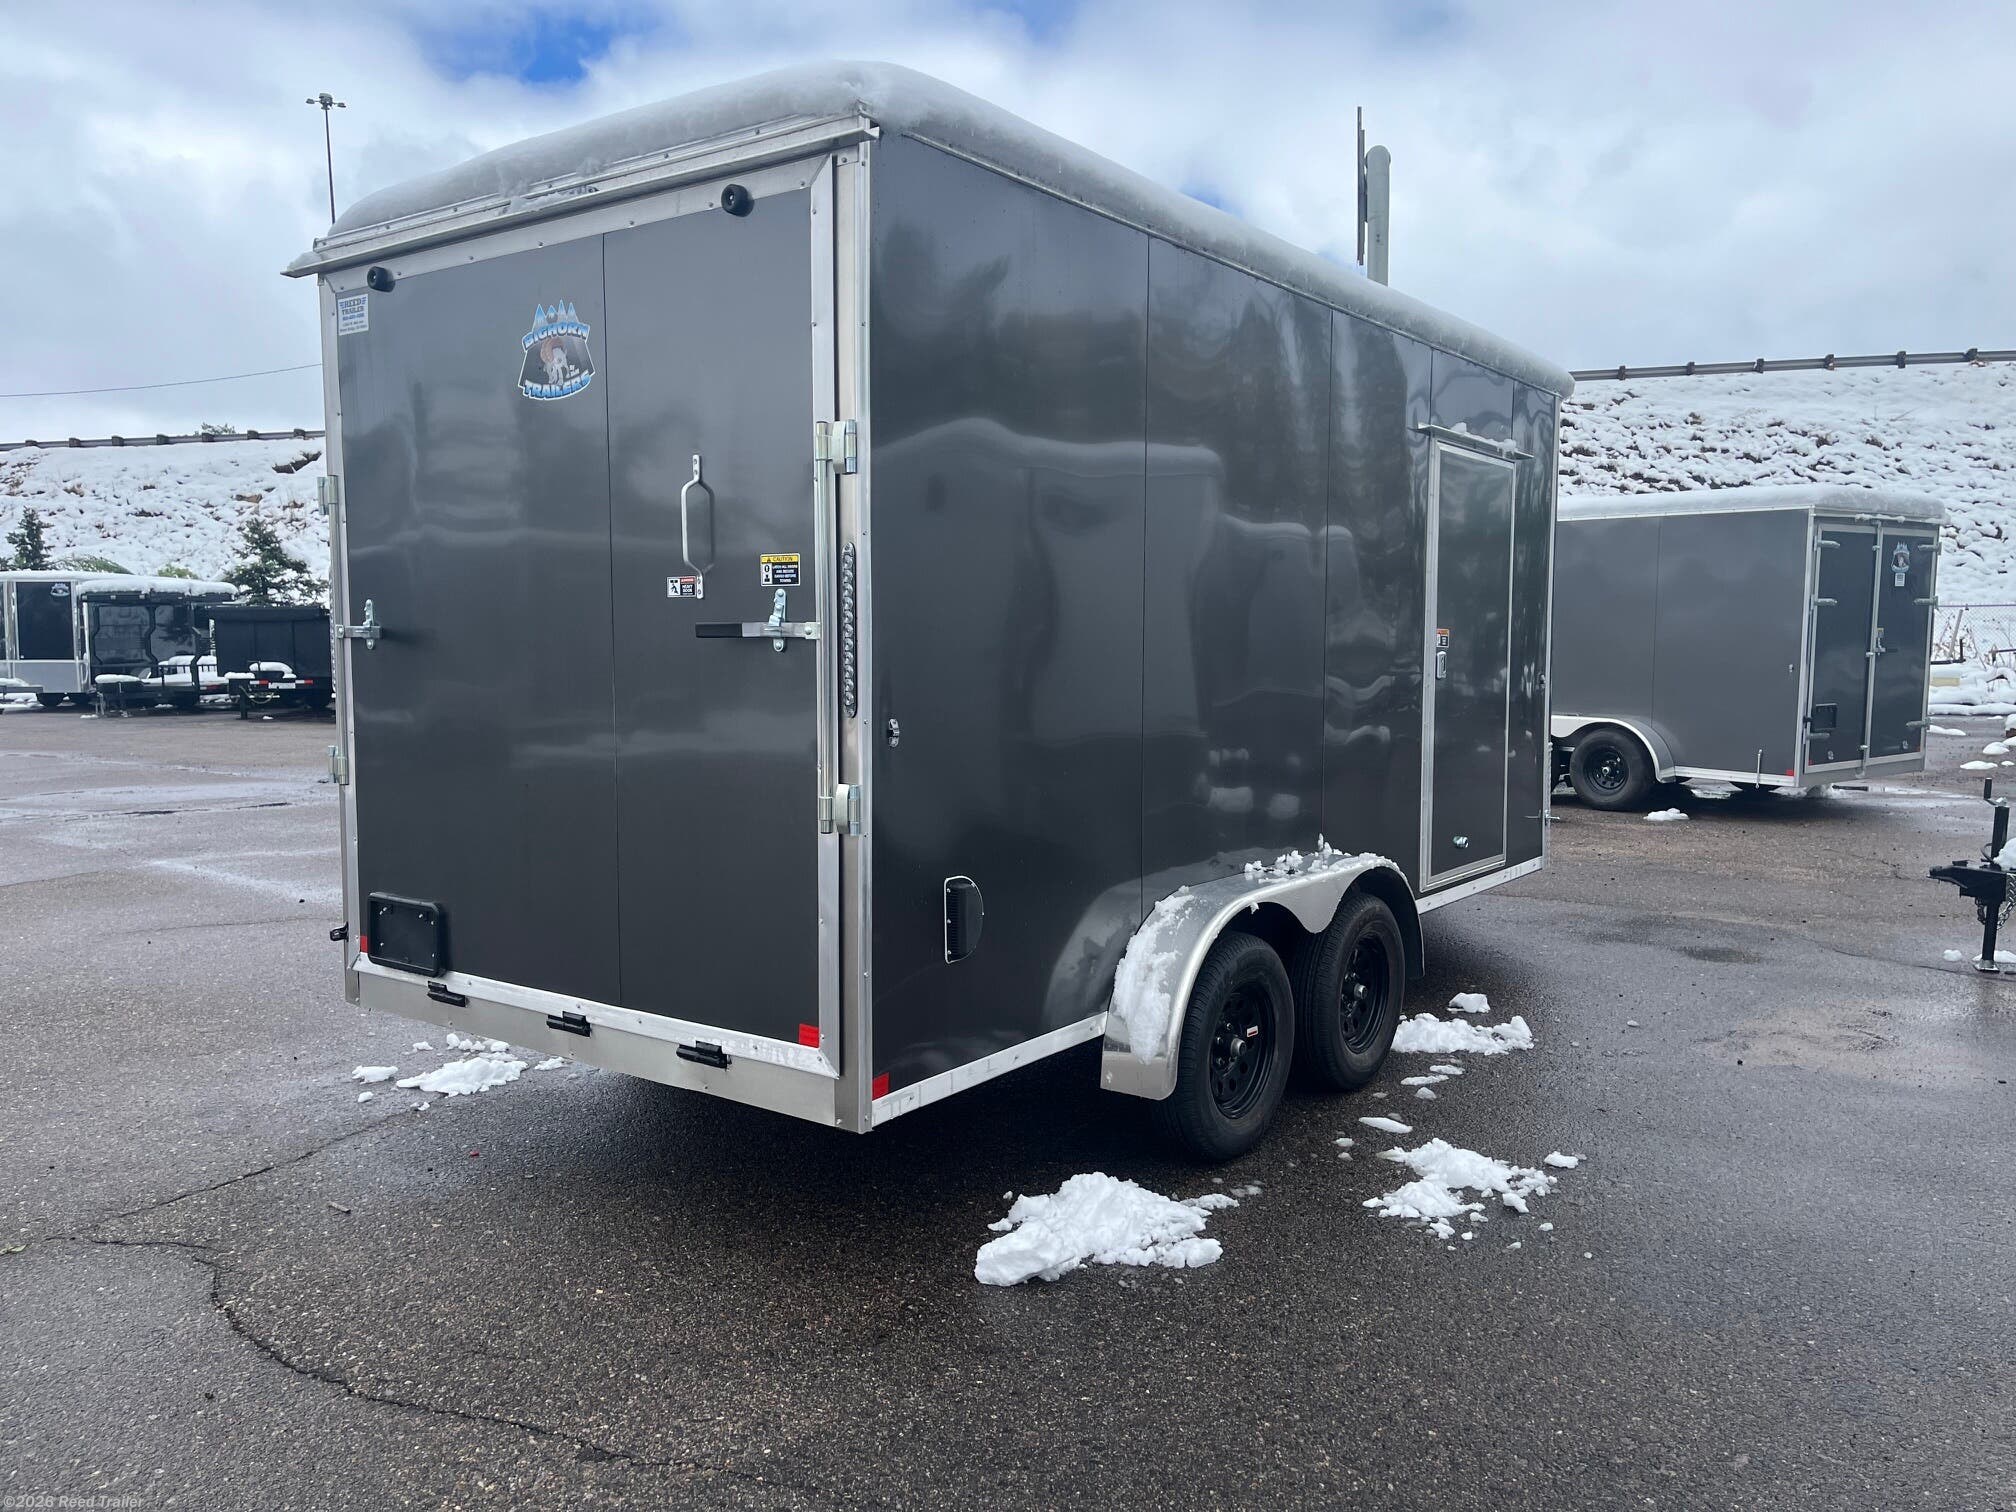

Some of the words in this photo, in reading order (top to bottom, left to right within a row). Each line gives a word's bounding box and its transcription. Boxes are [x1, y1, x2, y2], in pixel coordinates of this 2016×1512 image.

[344, 298, 361, 308] REED
[523, 321, 588, 350] BIGHORN
[524, 369, 591, 398] TRAILERS
